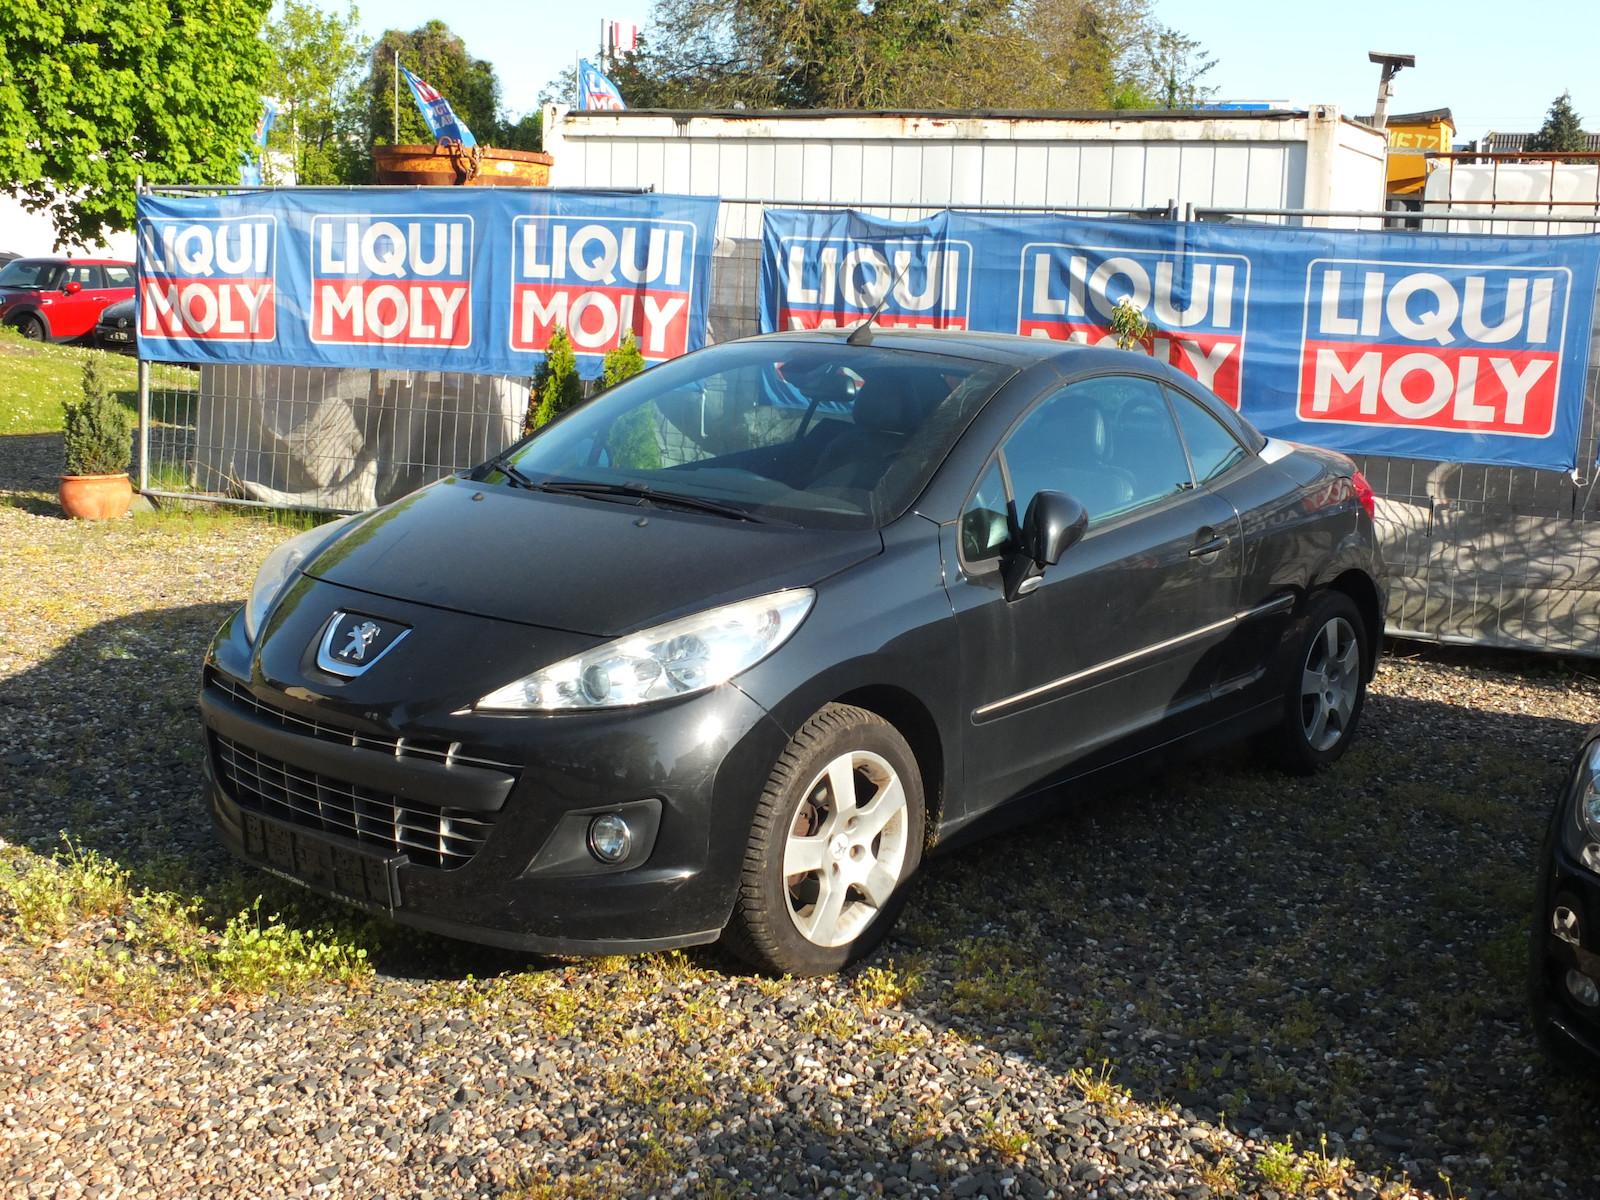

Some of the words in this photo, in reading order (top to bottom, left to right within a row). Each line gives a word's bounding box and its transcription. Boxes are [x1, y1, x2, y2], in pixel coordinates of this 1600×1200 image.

[145, 223, 269, 277] LIQUI
[321, 222, 463, 278] LIQUI
[523, 224, 684, 285] LIQUI
[787, 246, 960, 312] LIQUI
[146, 283, 271, 334] MOLY
[321, 285, 467, 340] MOLY
[521, 290, 686, 353] MOLY
[1033, 254, 1235, 328] LIQUI
[1320, 270, 1554, 346] LIQUI
[1312, 349, 1554, 425] MOLY
